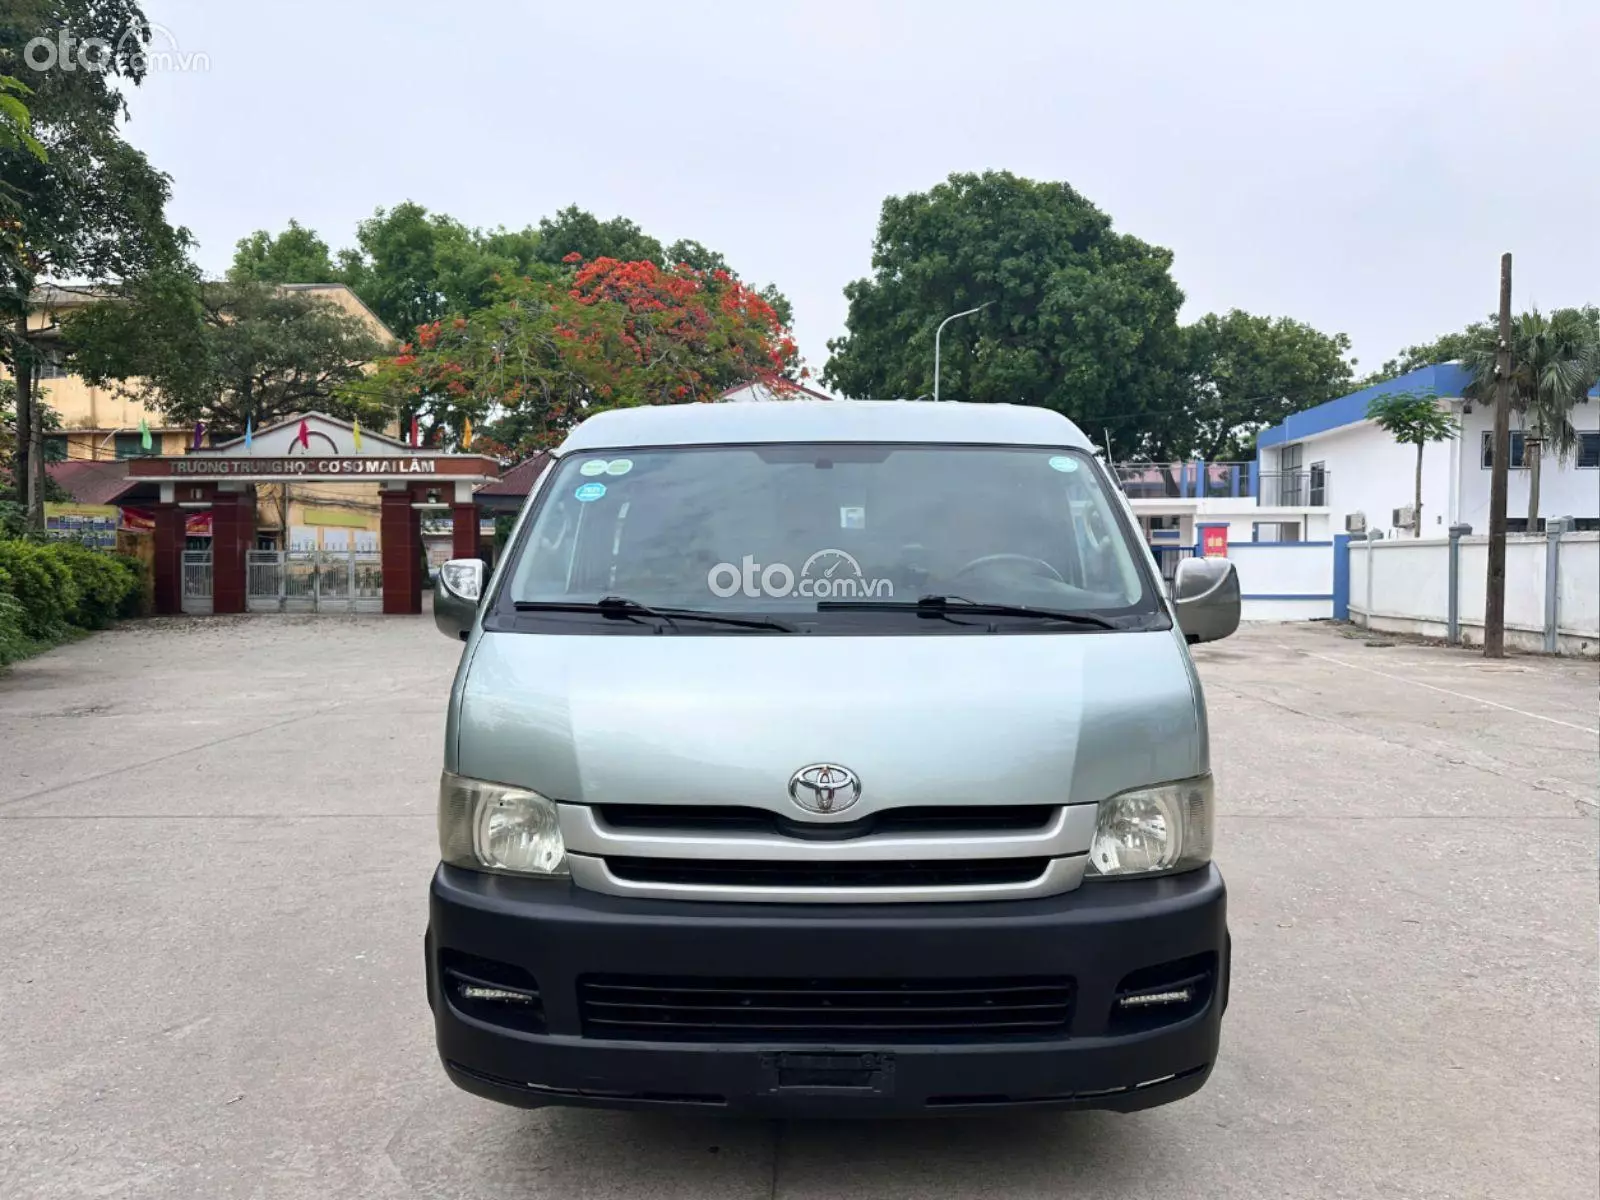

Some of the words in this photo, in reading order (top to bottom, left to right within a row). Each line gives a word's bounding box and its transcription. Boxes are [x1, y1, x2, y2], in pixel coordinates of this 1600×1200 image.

[232, 461, 281, 473] TRUNG
[284, 460, 316, 476] HỌC
[365, 460, 397, 473] MAI
